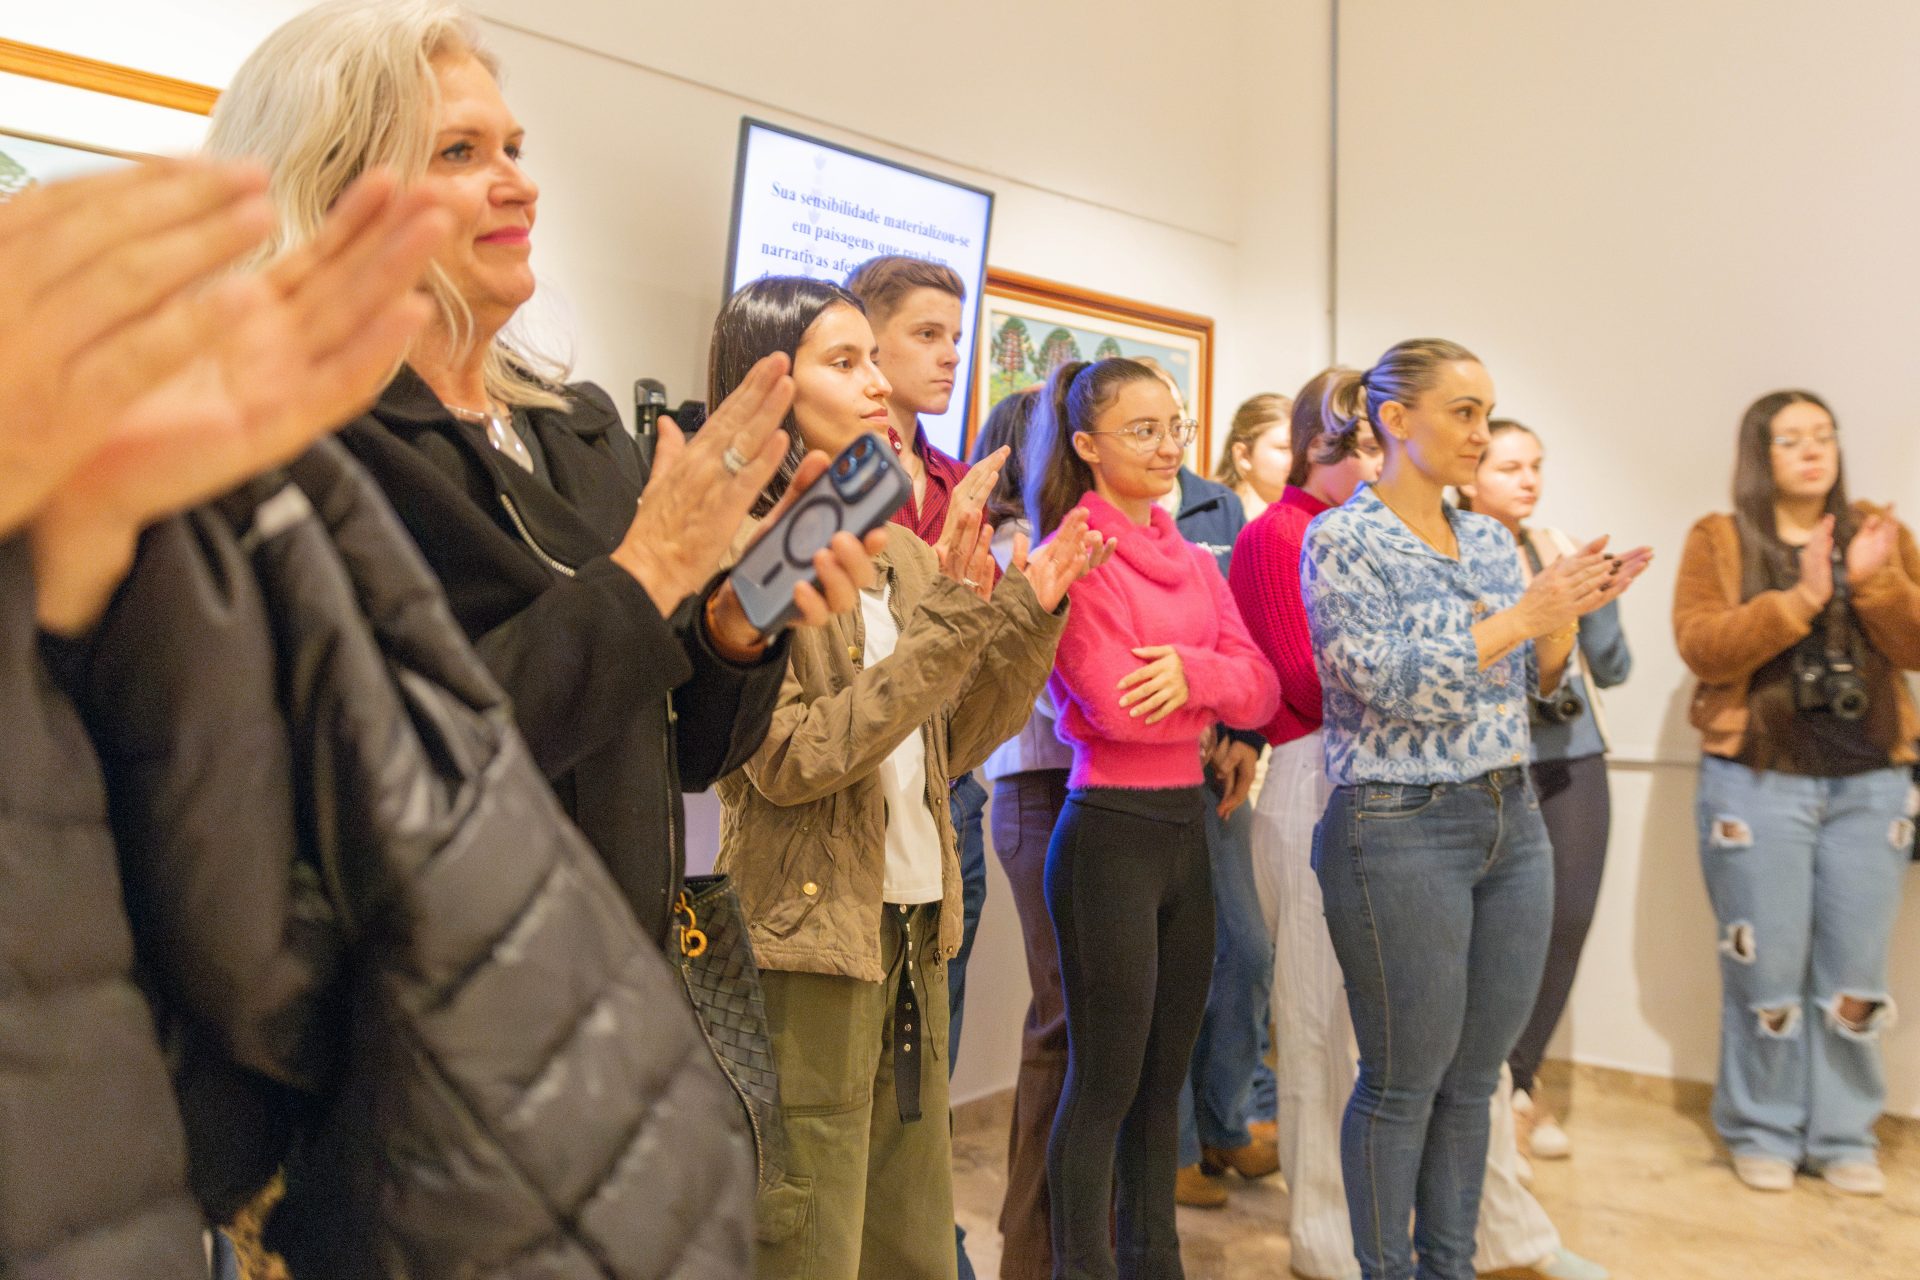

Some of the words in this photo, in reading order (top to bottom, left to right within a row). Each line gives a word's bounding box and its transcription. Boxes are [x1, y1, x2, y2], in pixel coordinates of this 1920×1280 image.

[772, 181, 796, 201] Sua
[800, 193, 881, 224] sensibilidade
[883, 215, 970, 248] materializou-se
[761, 242, 829, 269] narrativas
[792, 220, 811, 235] em
[815, 226, 875, 250] paisagens
[878, 242, 899, 256] que
